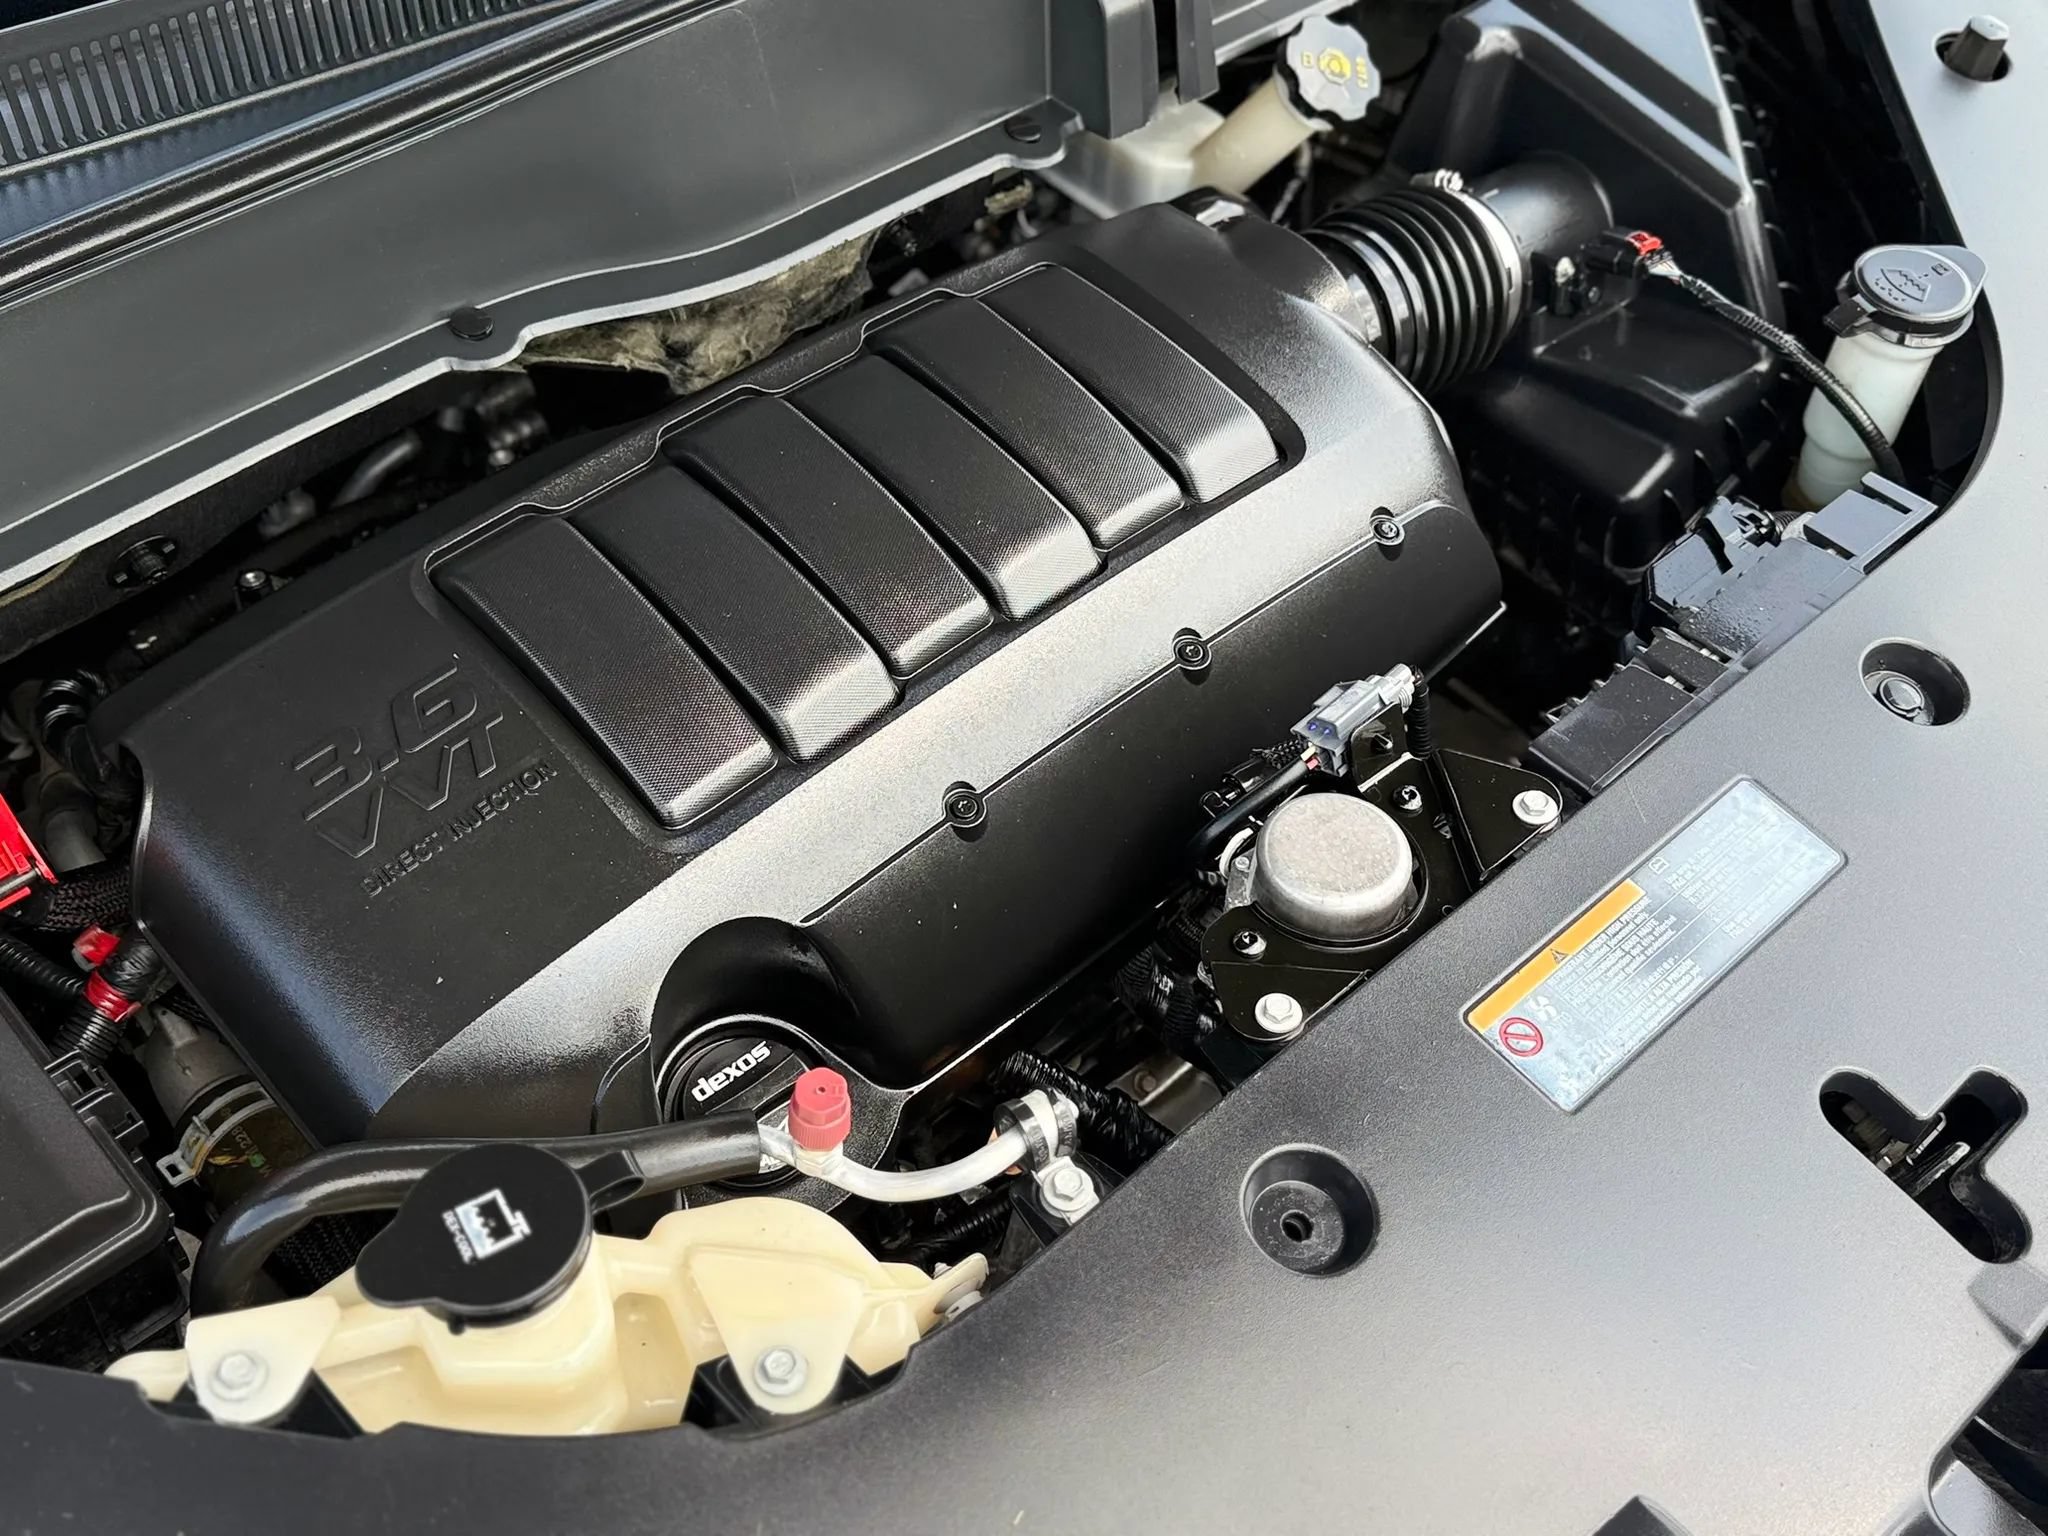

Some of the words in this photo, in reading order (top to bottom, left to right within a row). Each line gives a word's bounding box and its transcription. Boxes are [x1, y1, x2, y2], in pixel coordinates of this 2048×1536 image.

[360, 831, 444, 898] DIRECT
[448, 759, 558, 842] INJECTION
[691, 1040, 771, 1102] dexos
